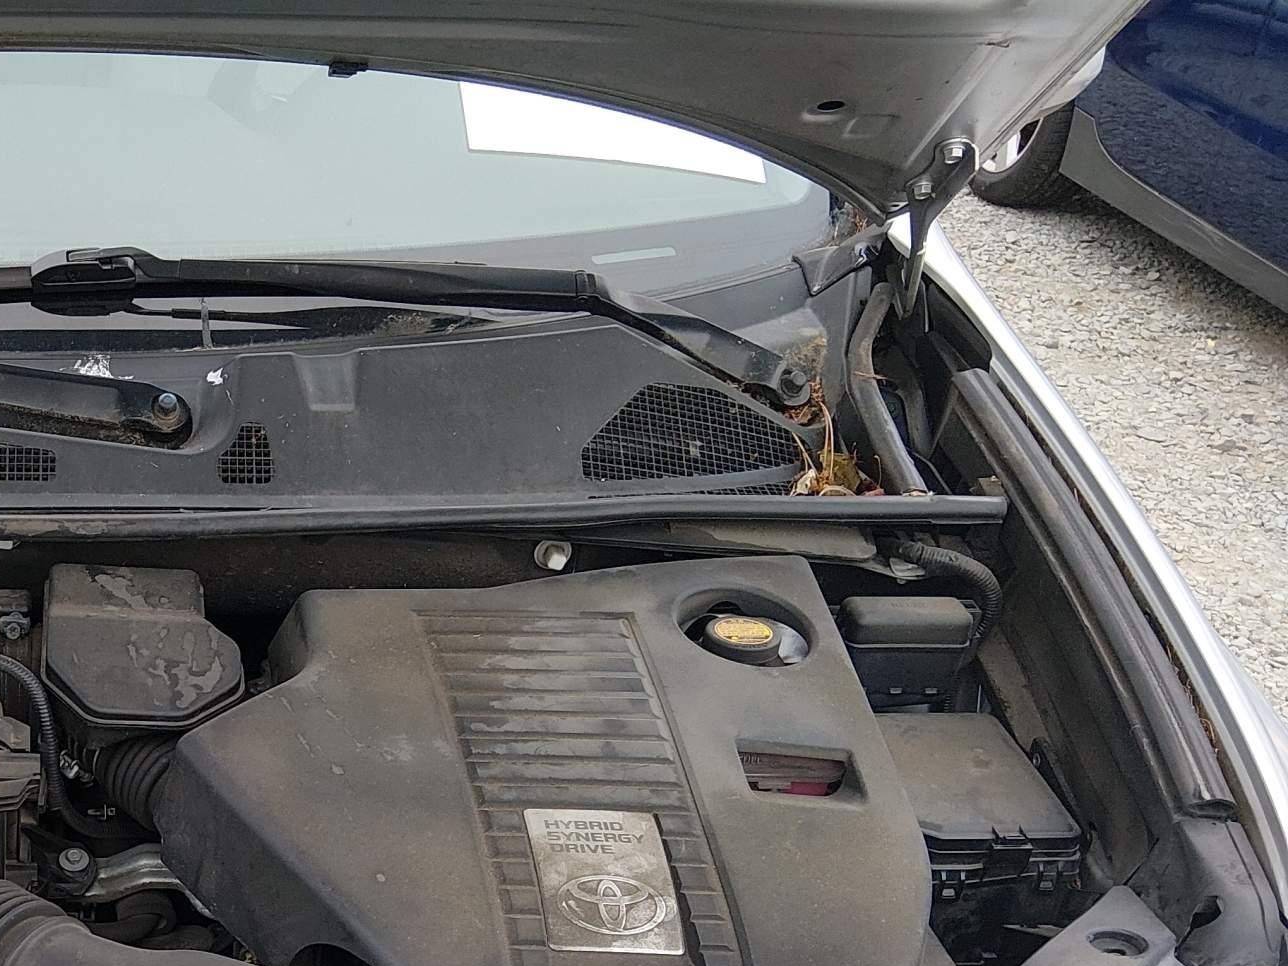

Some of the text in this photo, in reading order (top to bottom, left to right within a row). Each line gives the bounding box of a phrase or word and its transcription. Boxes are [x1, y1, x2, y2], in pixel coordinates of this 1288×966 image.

[544, 819, 623, 831] HYBRID
[547, 831, 644, 844] SYNERGY
[551, 843, 616, 854] DRIVE
